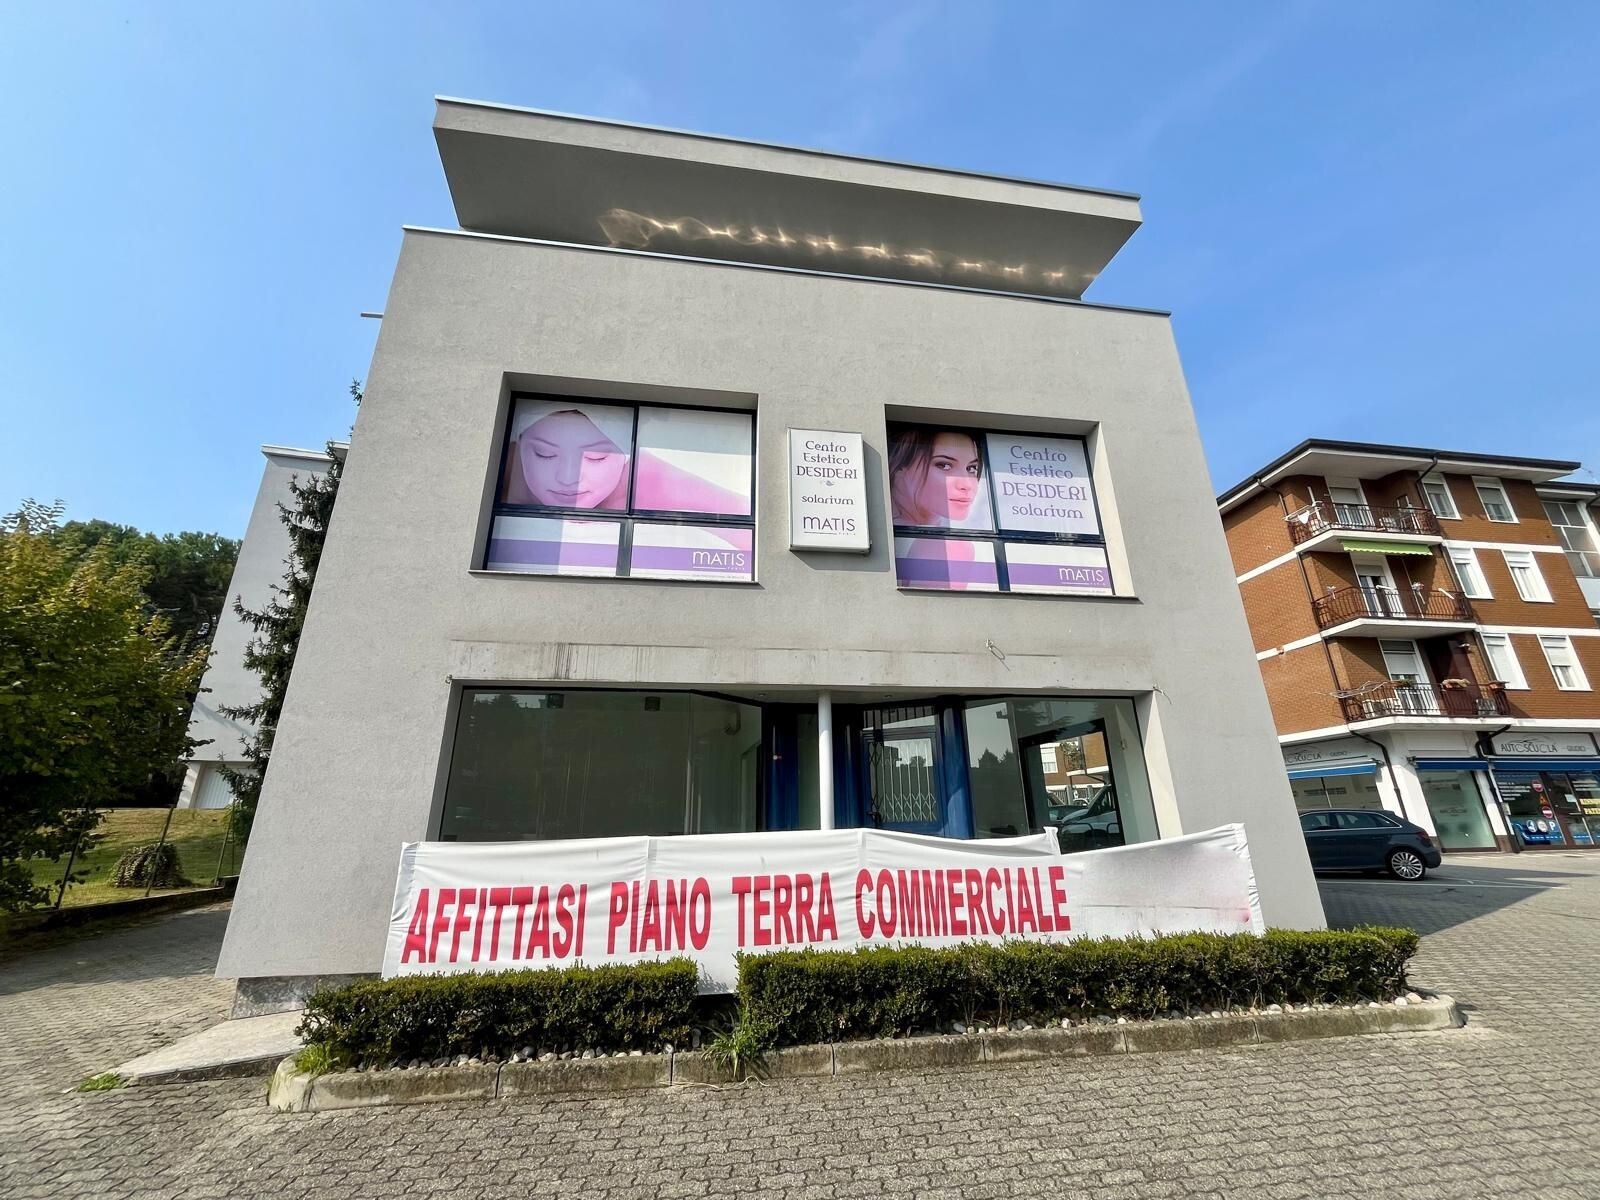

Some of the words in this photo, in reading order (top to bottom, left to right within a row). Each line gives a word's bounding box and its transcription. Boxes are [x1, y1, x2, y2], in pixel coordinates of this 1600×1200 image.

[805, 440, 847, 453] Centro
[1010, 445, 1067, 462] Centro
[803, 453, 850, 465] Estetico
[796, 465, 858, 479] DESIDERI
[1009, 462, 1073, 479] Estetico
[1001, 481, 1088, 501] DESIDERI
[801, 494, 854, 505] solarium
[1011, 503, 1084, 519] solarium
[400, 883, 588, 964] AFFITTASI
[606, 877, 711, 954] PIANO
[732, 873, 838, 947] TERRA
[855, 865, 1071, 940] COMMERCIALE
